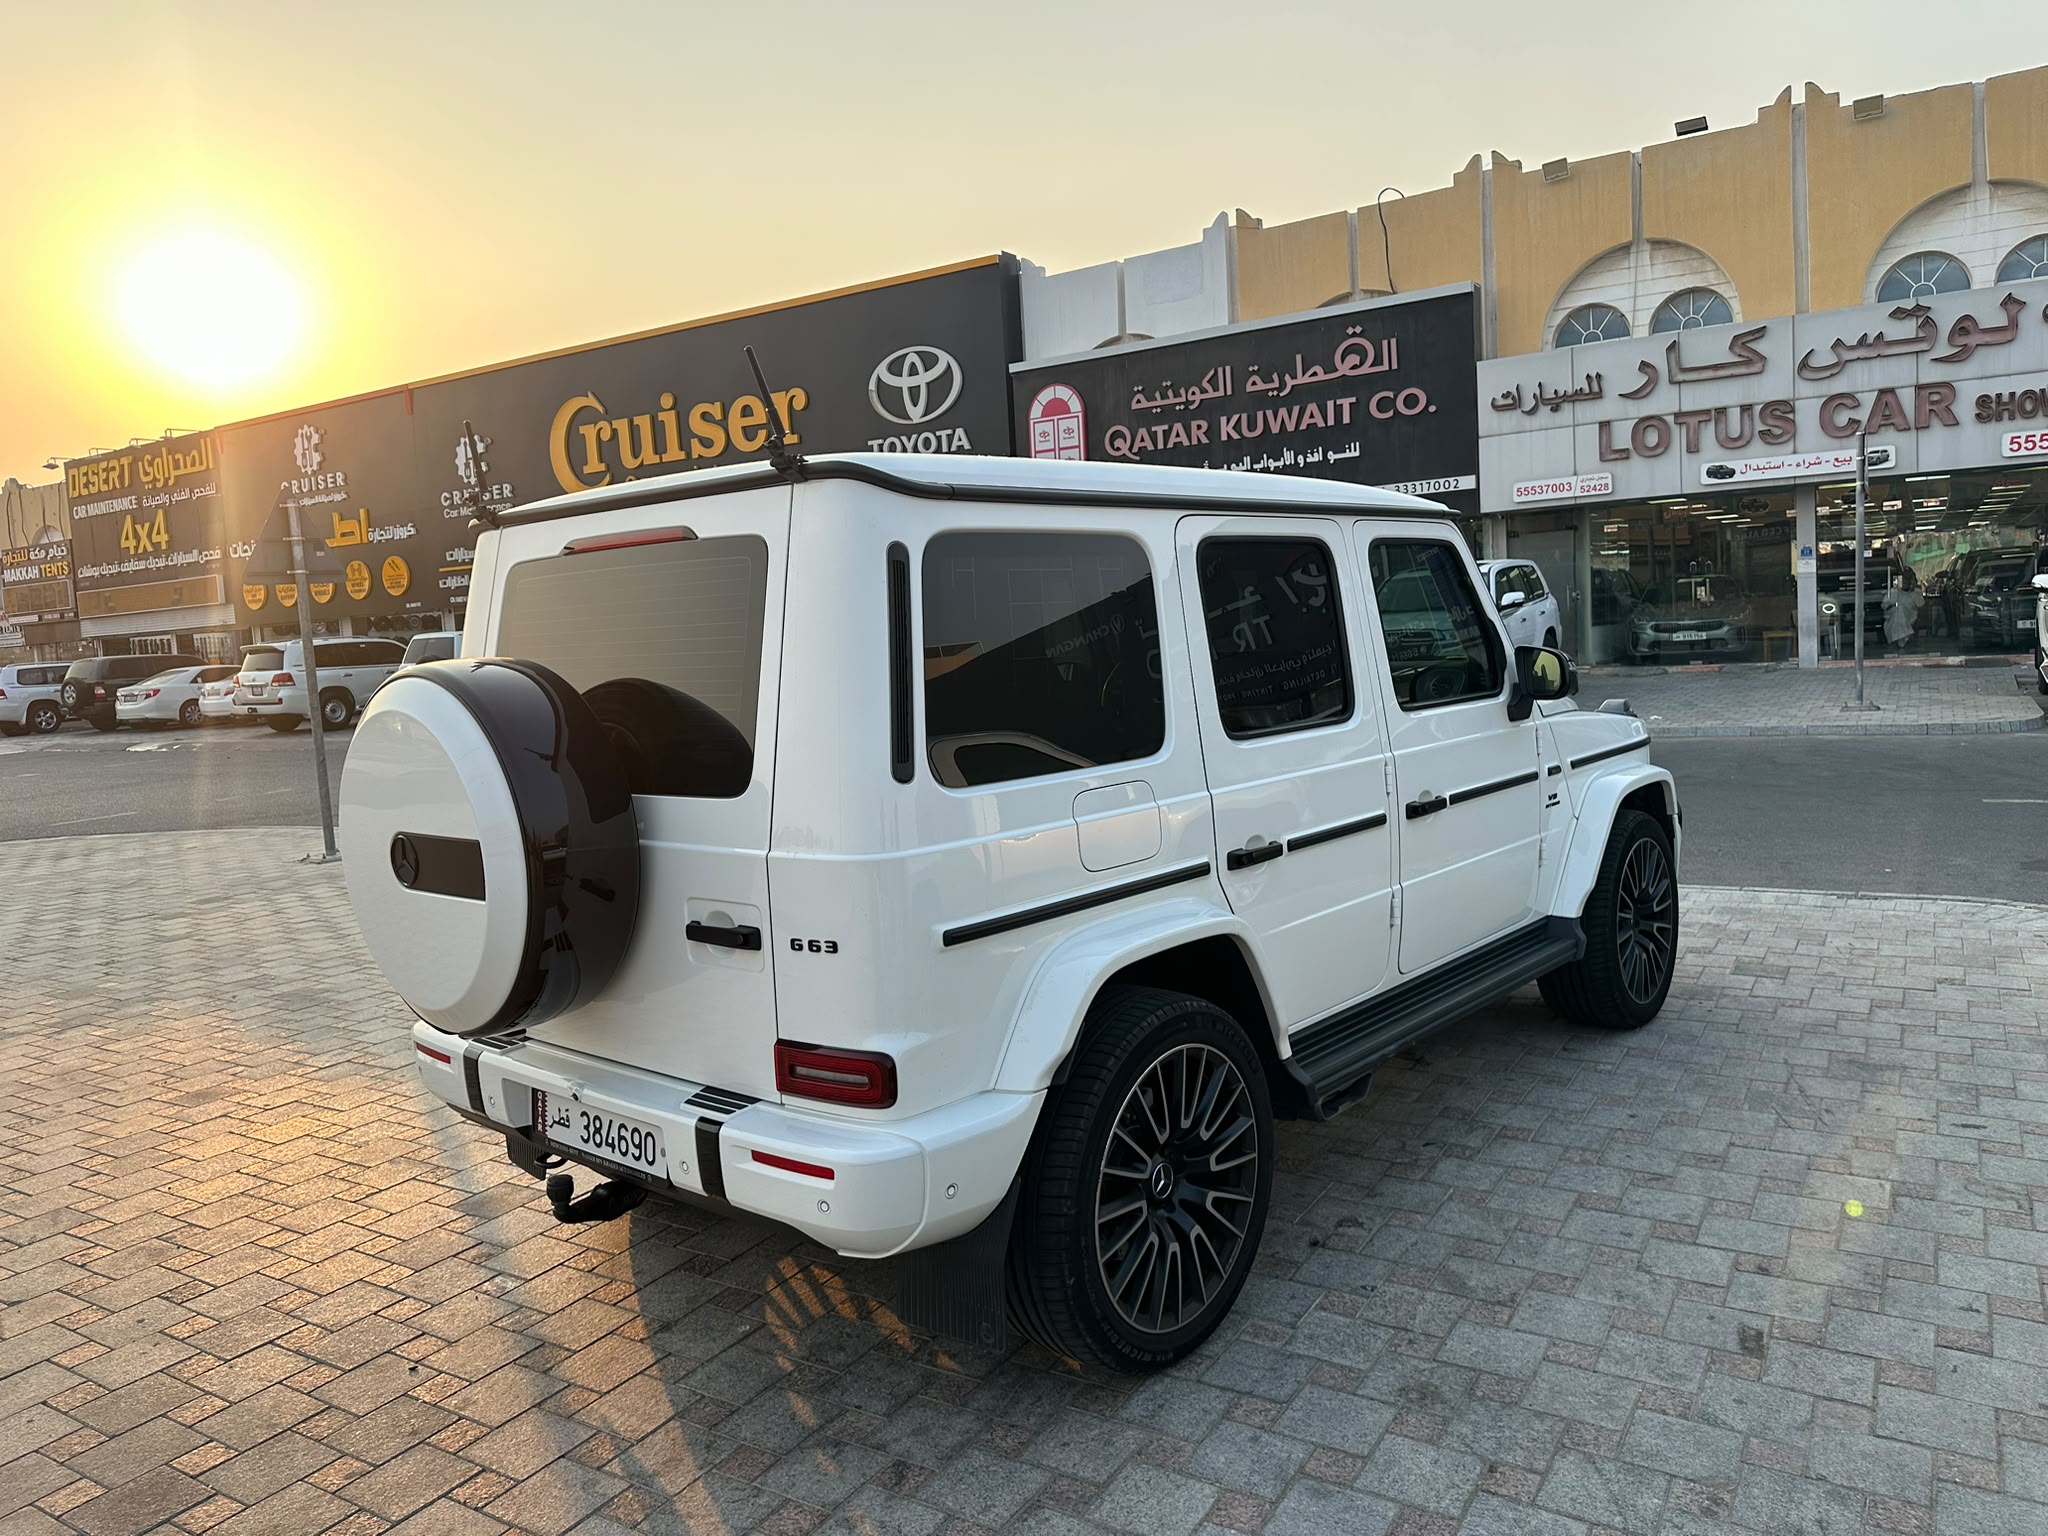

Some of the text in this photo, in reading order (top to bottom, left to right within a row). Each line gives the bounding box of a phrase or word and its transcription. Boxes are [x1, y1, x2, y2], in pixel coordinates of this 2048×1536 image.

[1131, 325, 1398, 415] القطرية الكويتية
[1490, 292, 2027, 416] لوتس كار للسيارات
[1104, 387, 1437, 460] QATAR KUWAIT CO.
[1599, 399, 1797, 462] LOTUS
[1819, 382, 1960, 438] CAR
[549, 387, 809, 494] Cruiser
[867, 427, 972, 454] TOYOTA
[68, 456, 134, 498] DESERT
[1740, 455, 1853, 475] بيع شراء استبدال
[1516, 482, 1573, 497] 55537003
[1580, 483, 1609, 494] 52428
[73, 495, 138, 519] CAR MAINTENANCE
[120, 509, 170, 555] 4x4
[29, 547, 47, 561] مكة
[3, 561, 70, 583] MAKKAH TENTS
[549, 1106, 571, 1129] قطر
[580, 1111, 656, 1166] 384690
